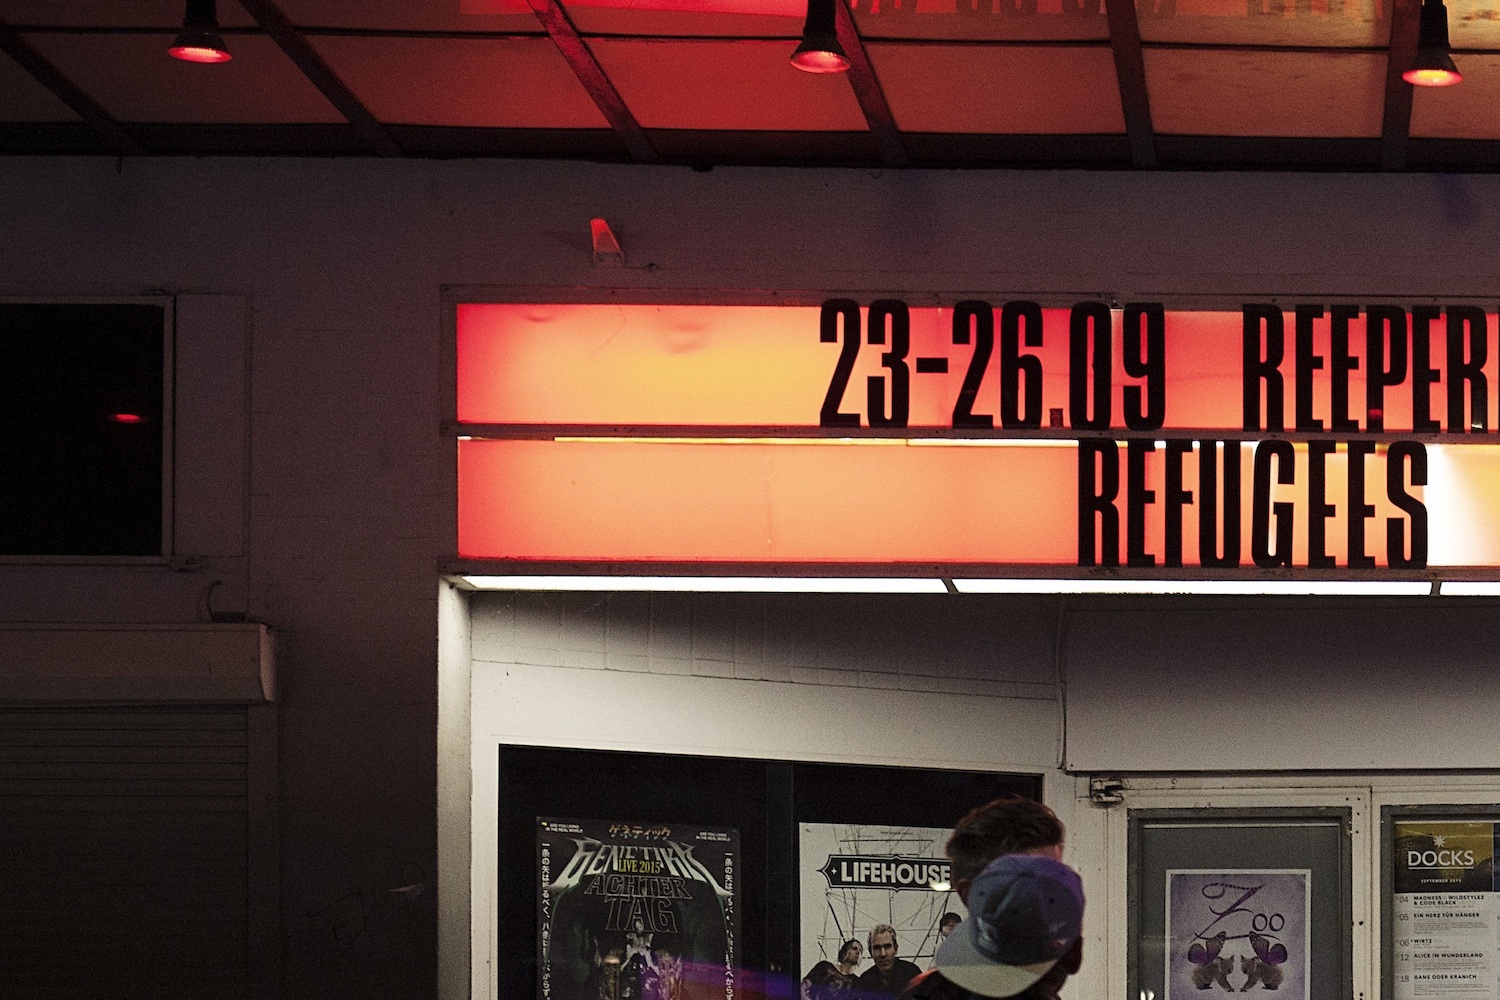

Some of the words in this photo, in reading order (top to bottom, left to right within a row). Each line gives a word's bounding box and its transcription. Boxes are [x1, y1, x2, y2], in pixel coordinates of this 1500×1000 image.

[820, 300, 1165, 430] 23-26.09
[1079, 440, 1428, 568] REFUGEES
[618, 860, 637, 873] LIVE
[640, 861, 661, 874] 2015
[1408, 850, 1474, 866] DOCKS
[841, 862, 950, 884] LIFEHOUSE
[584, 874, 693, 899] ACHTER
[605, 895, 678, 933] TAG
